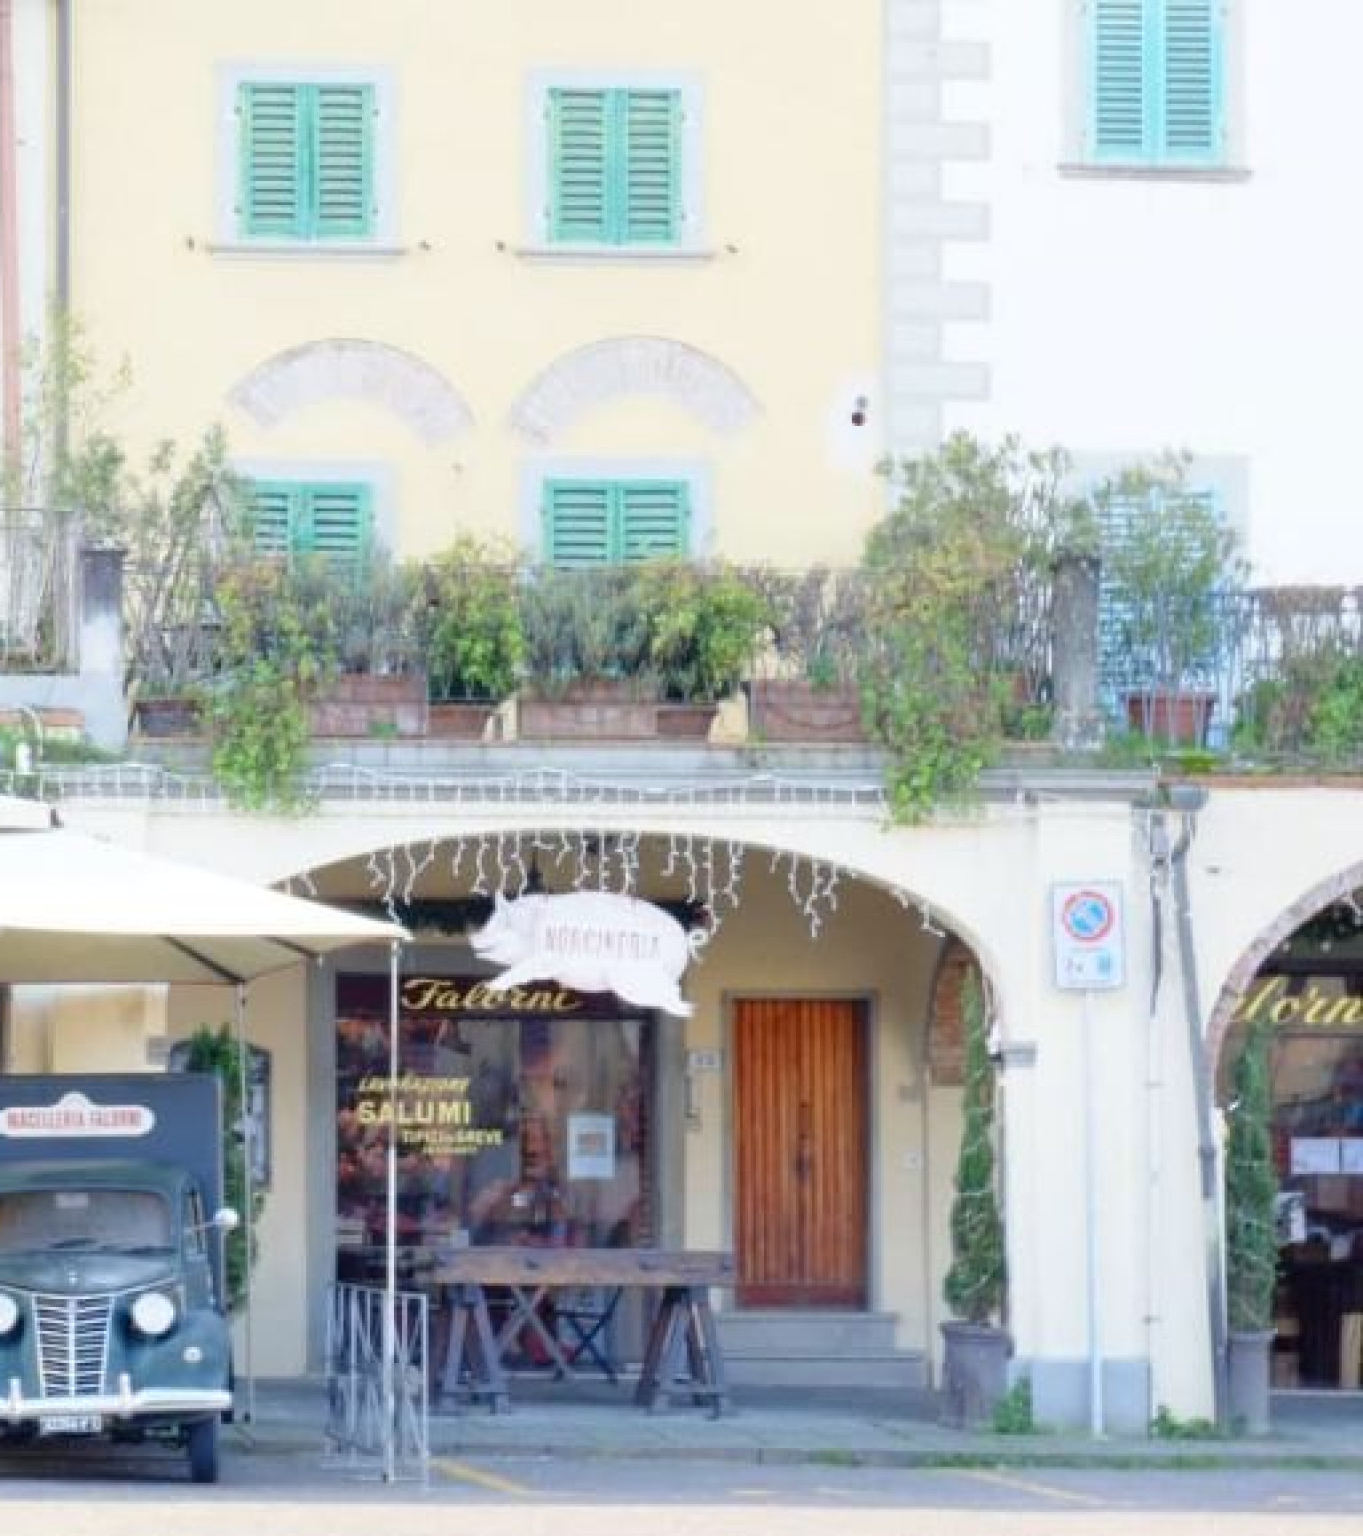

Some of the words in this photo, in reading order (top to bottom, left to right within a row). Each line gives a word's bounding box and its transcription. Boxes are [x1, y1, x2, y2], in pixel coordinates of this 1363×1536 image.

[545, 926, 660, 959] NORCINERIA
[402, 978, 582, 1010] Falorni
[359, 1101, 471, 1124] SALUMI
